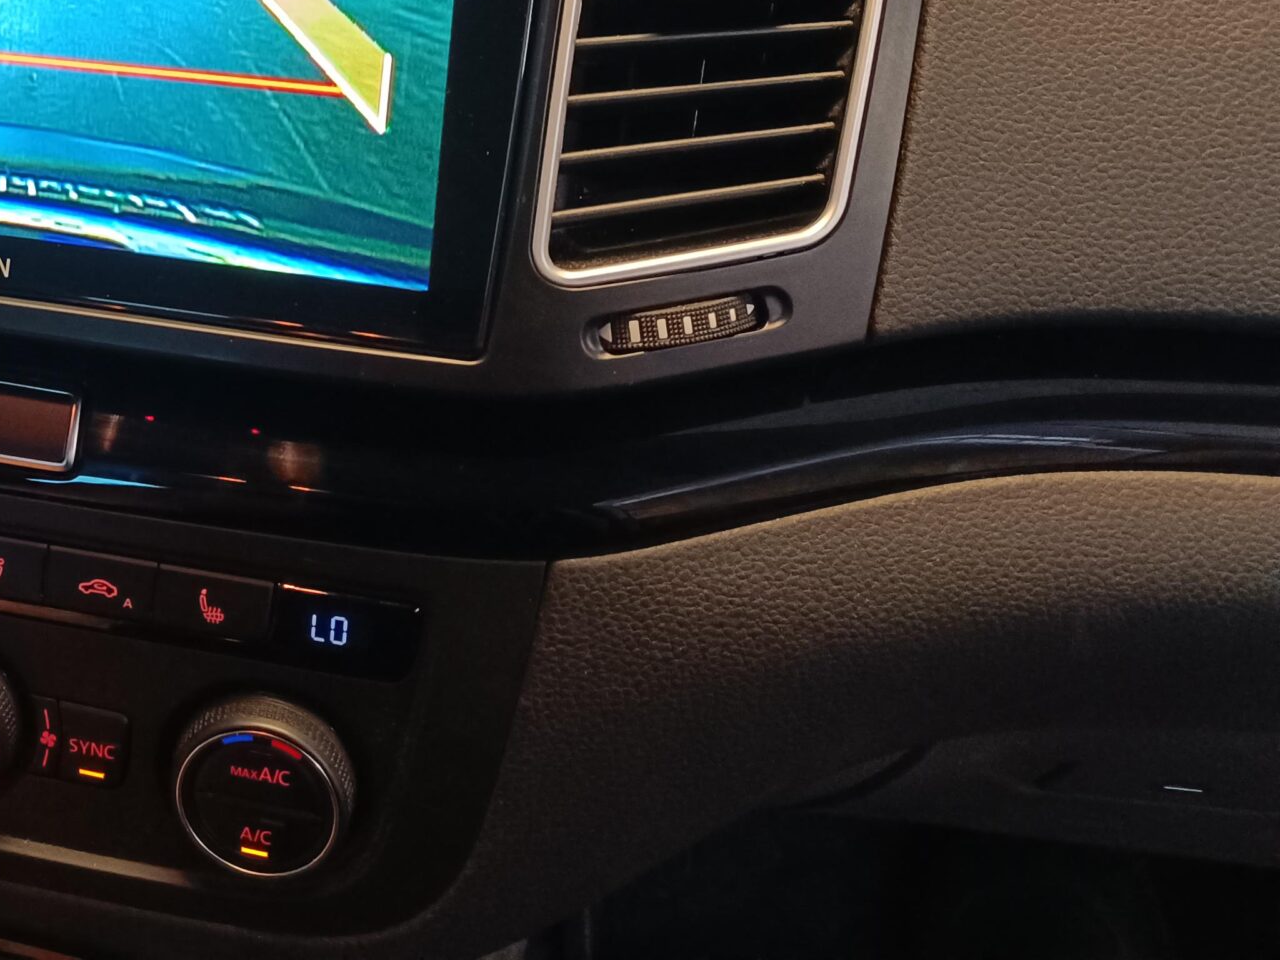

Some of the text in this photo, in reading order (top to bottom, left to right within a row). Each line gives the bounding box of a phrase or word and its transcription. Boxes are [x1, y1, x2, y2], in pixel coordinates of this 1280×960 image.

[122, 597, 133, 609] A
[310, 613, 349, 646] LO
[68, 737, 117, 760] SYNC
[259, 767, 292, 787] A/C
[239, 826, 273, 846] A/C
